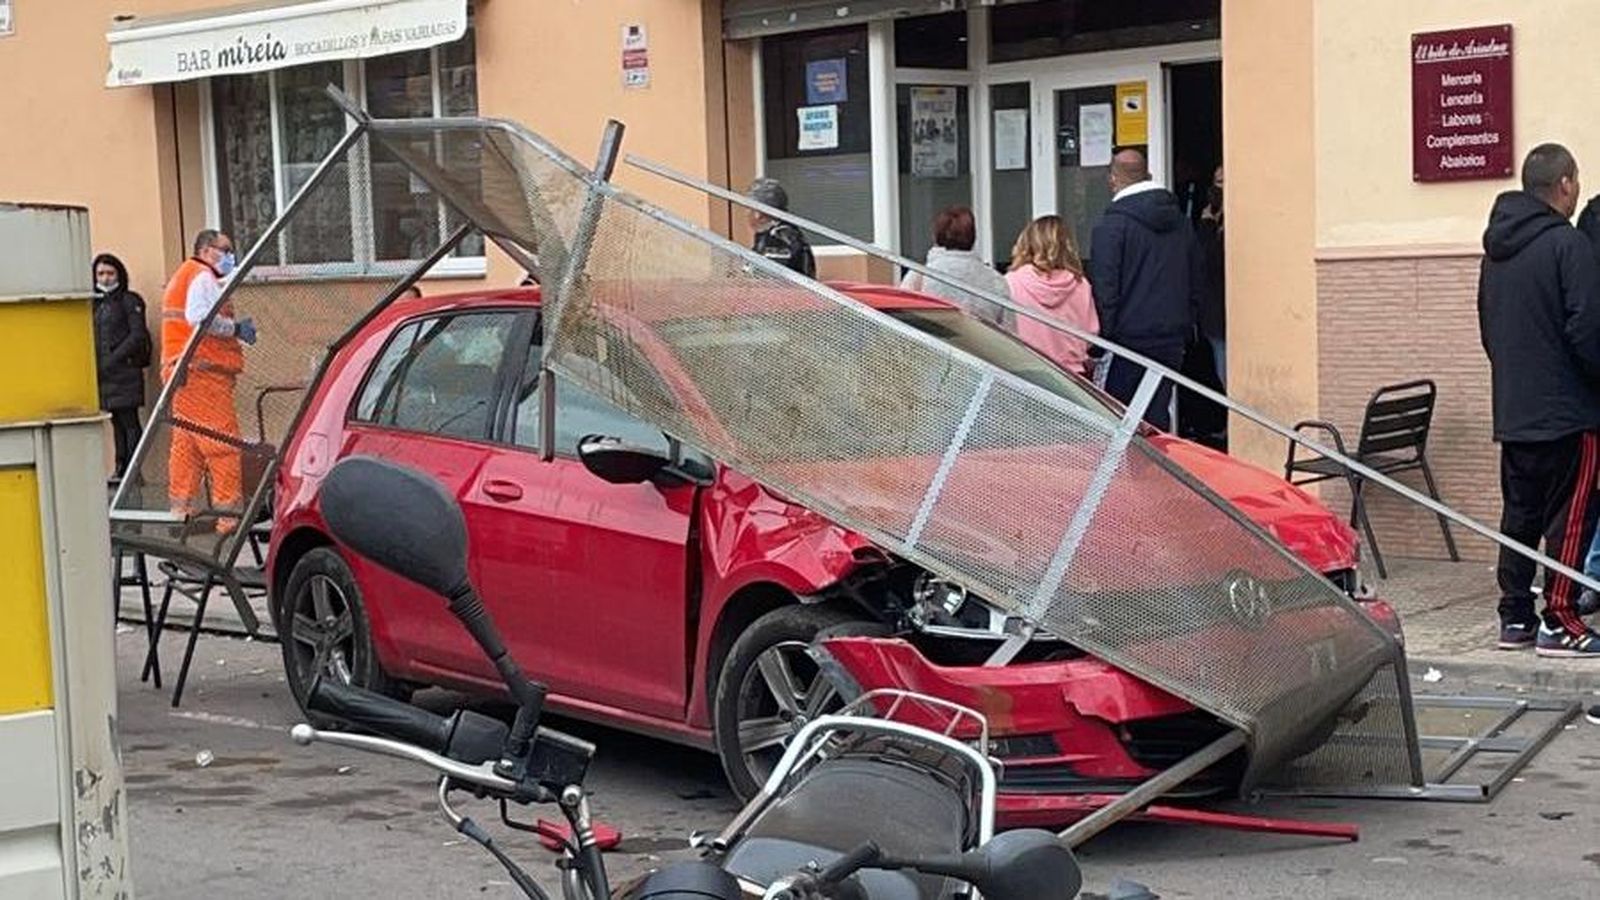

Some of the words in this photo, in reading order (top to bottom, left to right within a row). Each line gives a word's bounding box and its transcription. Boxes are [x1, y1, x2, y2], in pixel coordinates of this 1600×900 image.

[1448, 41, 1465, 56] de
[177, 50, 212, 73] BAR
[1442, 112, 1482, 127] Labores
[1426, 131, 1499, 150] Complementos
[1440, 154, 1486, 168] Abalorios
